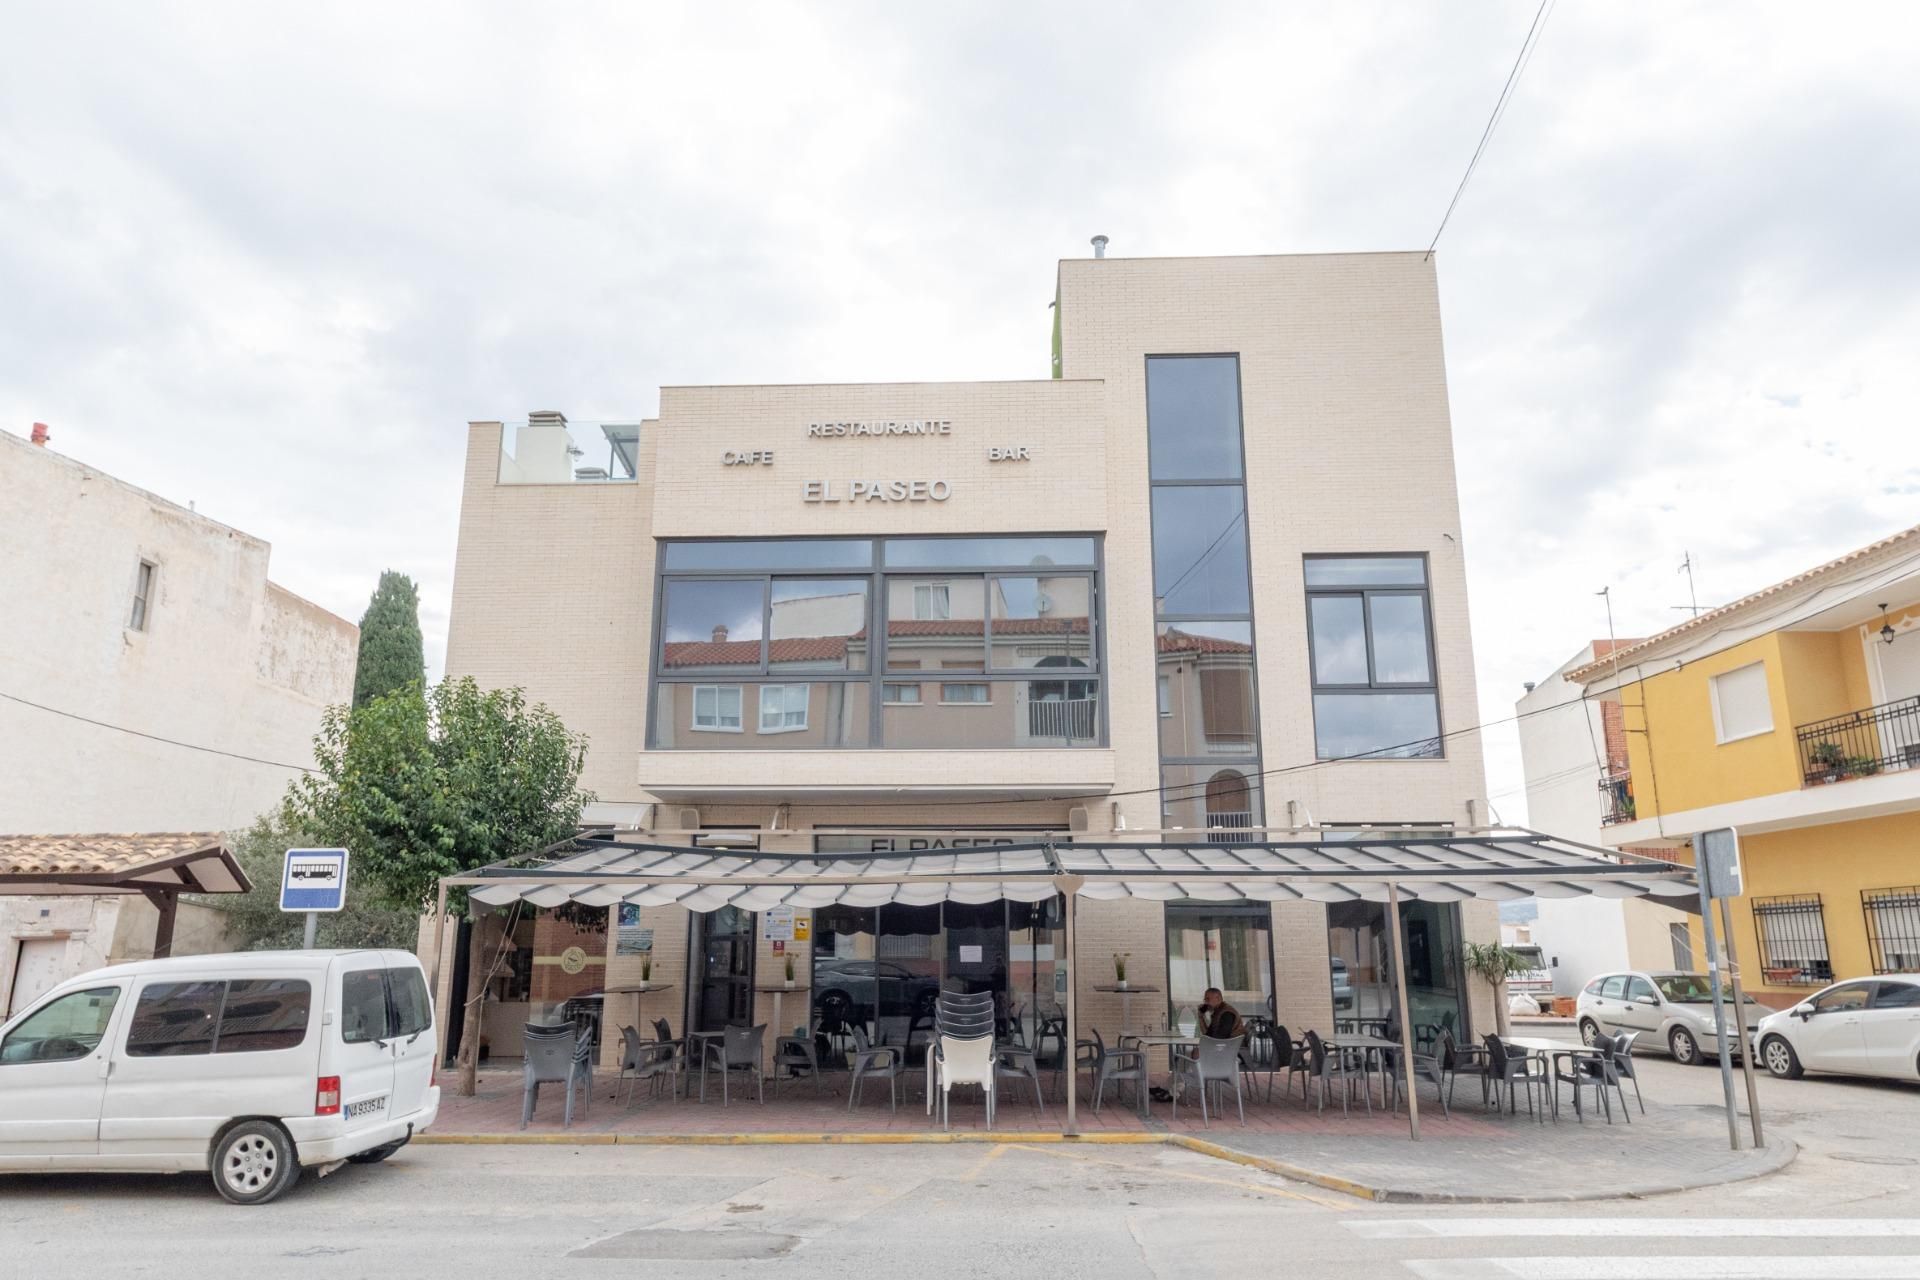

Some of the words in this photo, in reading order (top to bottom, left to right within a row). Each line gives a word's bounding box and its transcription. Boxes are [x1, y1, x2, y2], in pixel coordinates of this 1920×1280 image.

[808, 420, 952, 437] RESTAURANTE
[721, 449, 774, 466] CAFE
[988, 446, 1031, 462] BAR
[802, 480, 841, 503] EL
[849, 479, 952, 503] PASEO
